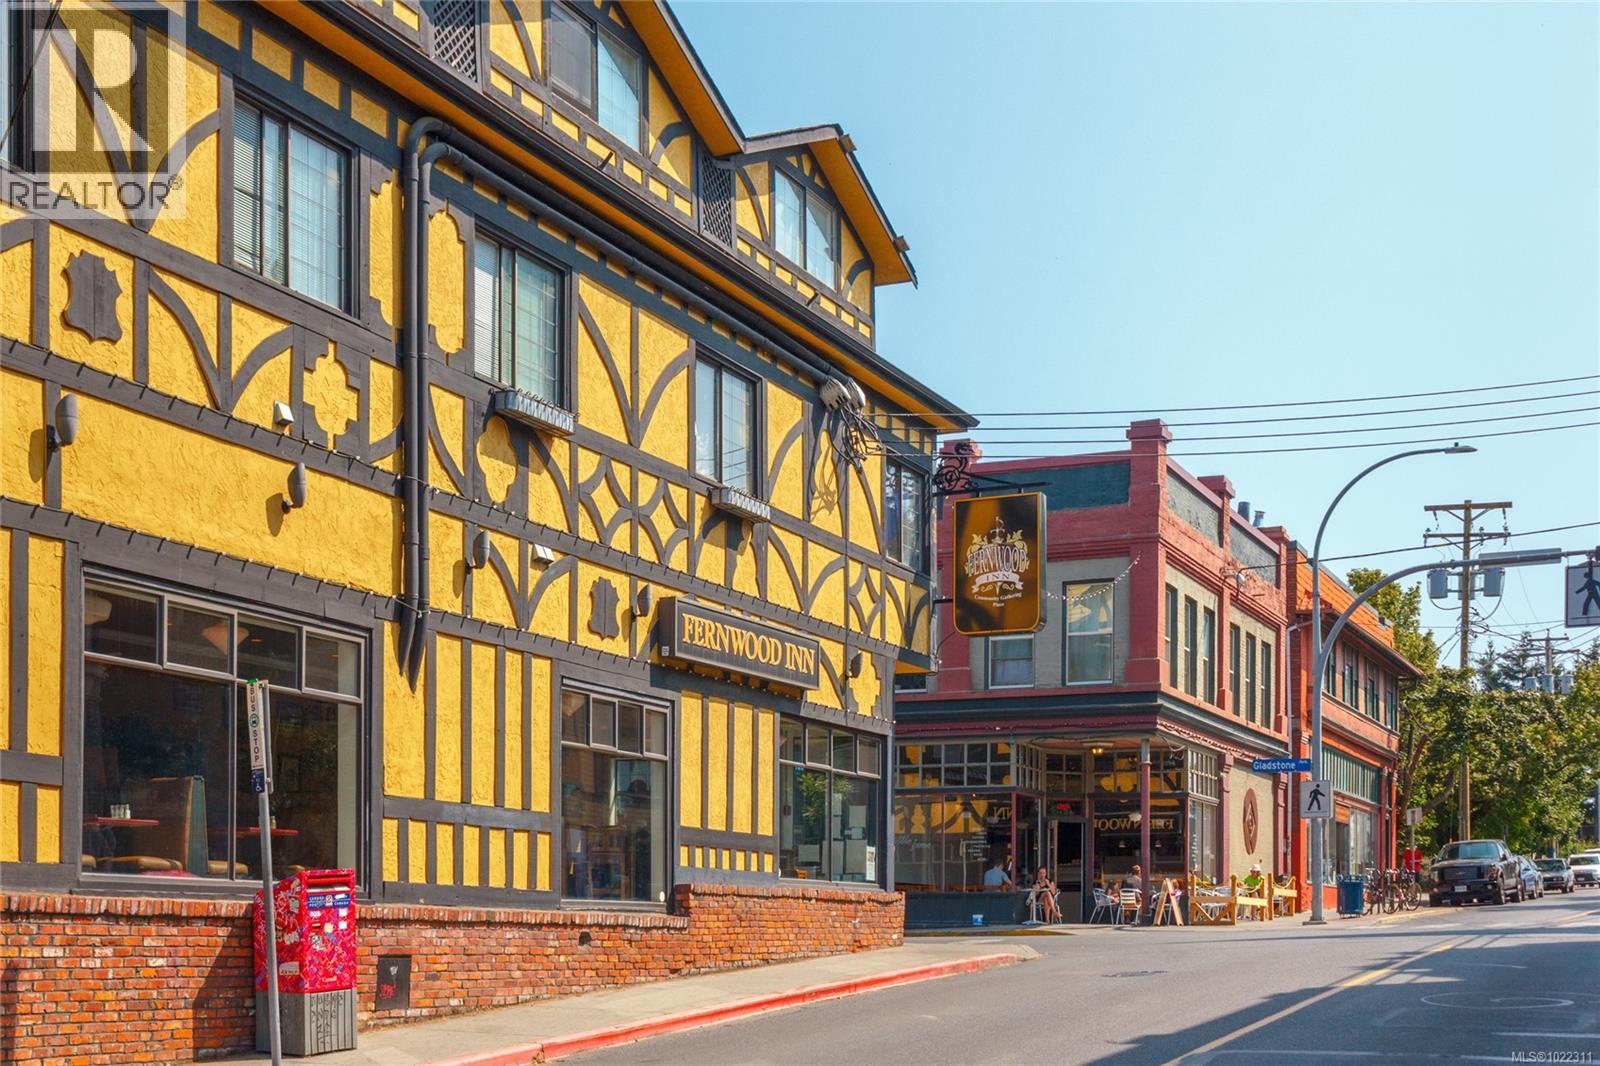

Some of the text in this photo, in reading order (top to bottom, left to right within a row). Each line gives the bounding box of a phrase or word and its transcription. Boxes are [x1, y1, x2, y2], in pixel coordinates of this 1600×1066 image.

[968, 545, 1027, 577] FERNWOOD
[985, 573, 1011, 581] INN
[681, 612, 816, 675] FERNWOOD INN
[253, 729, 261, 762] STOP
[1253, 761, 1296, 770] Gladstone
